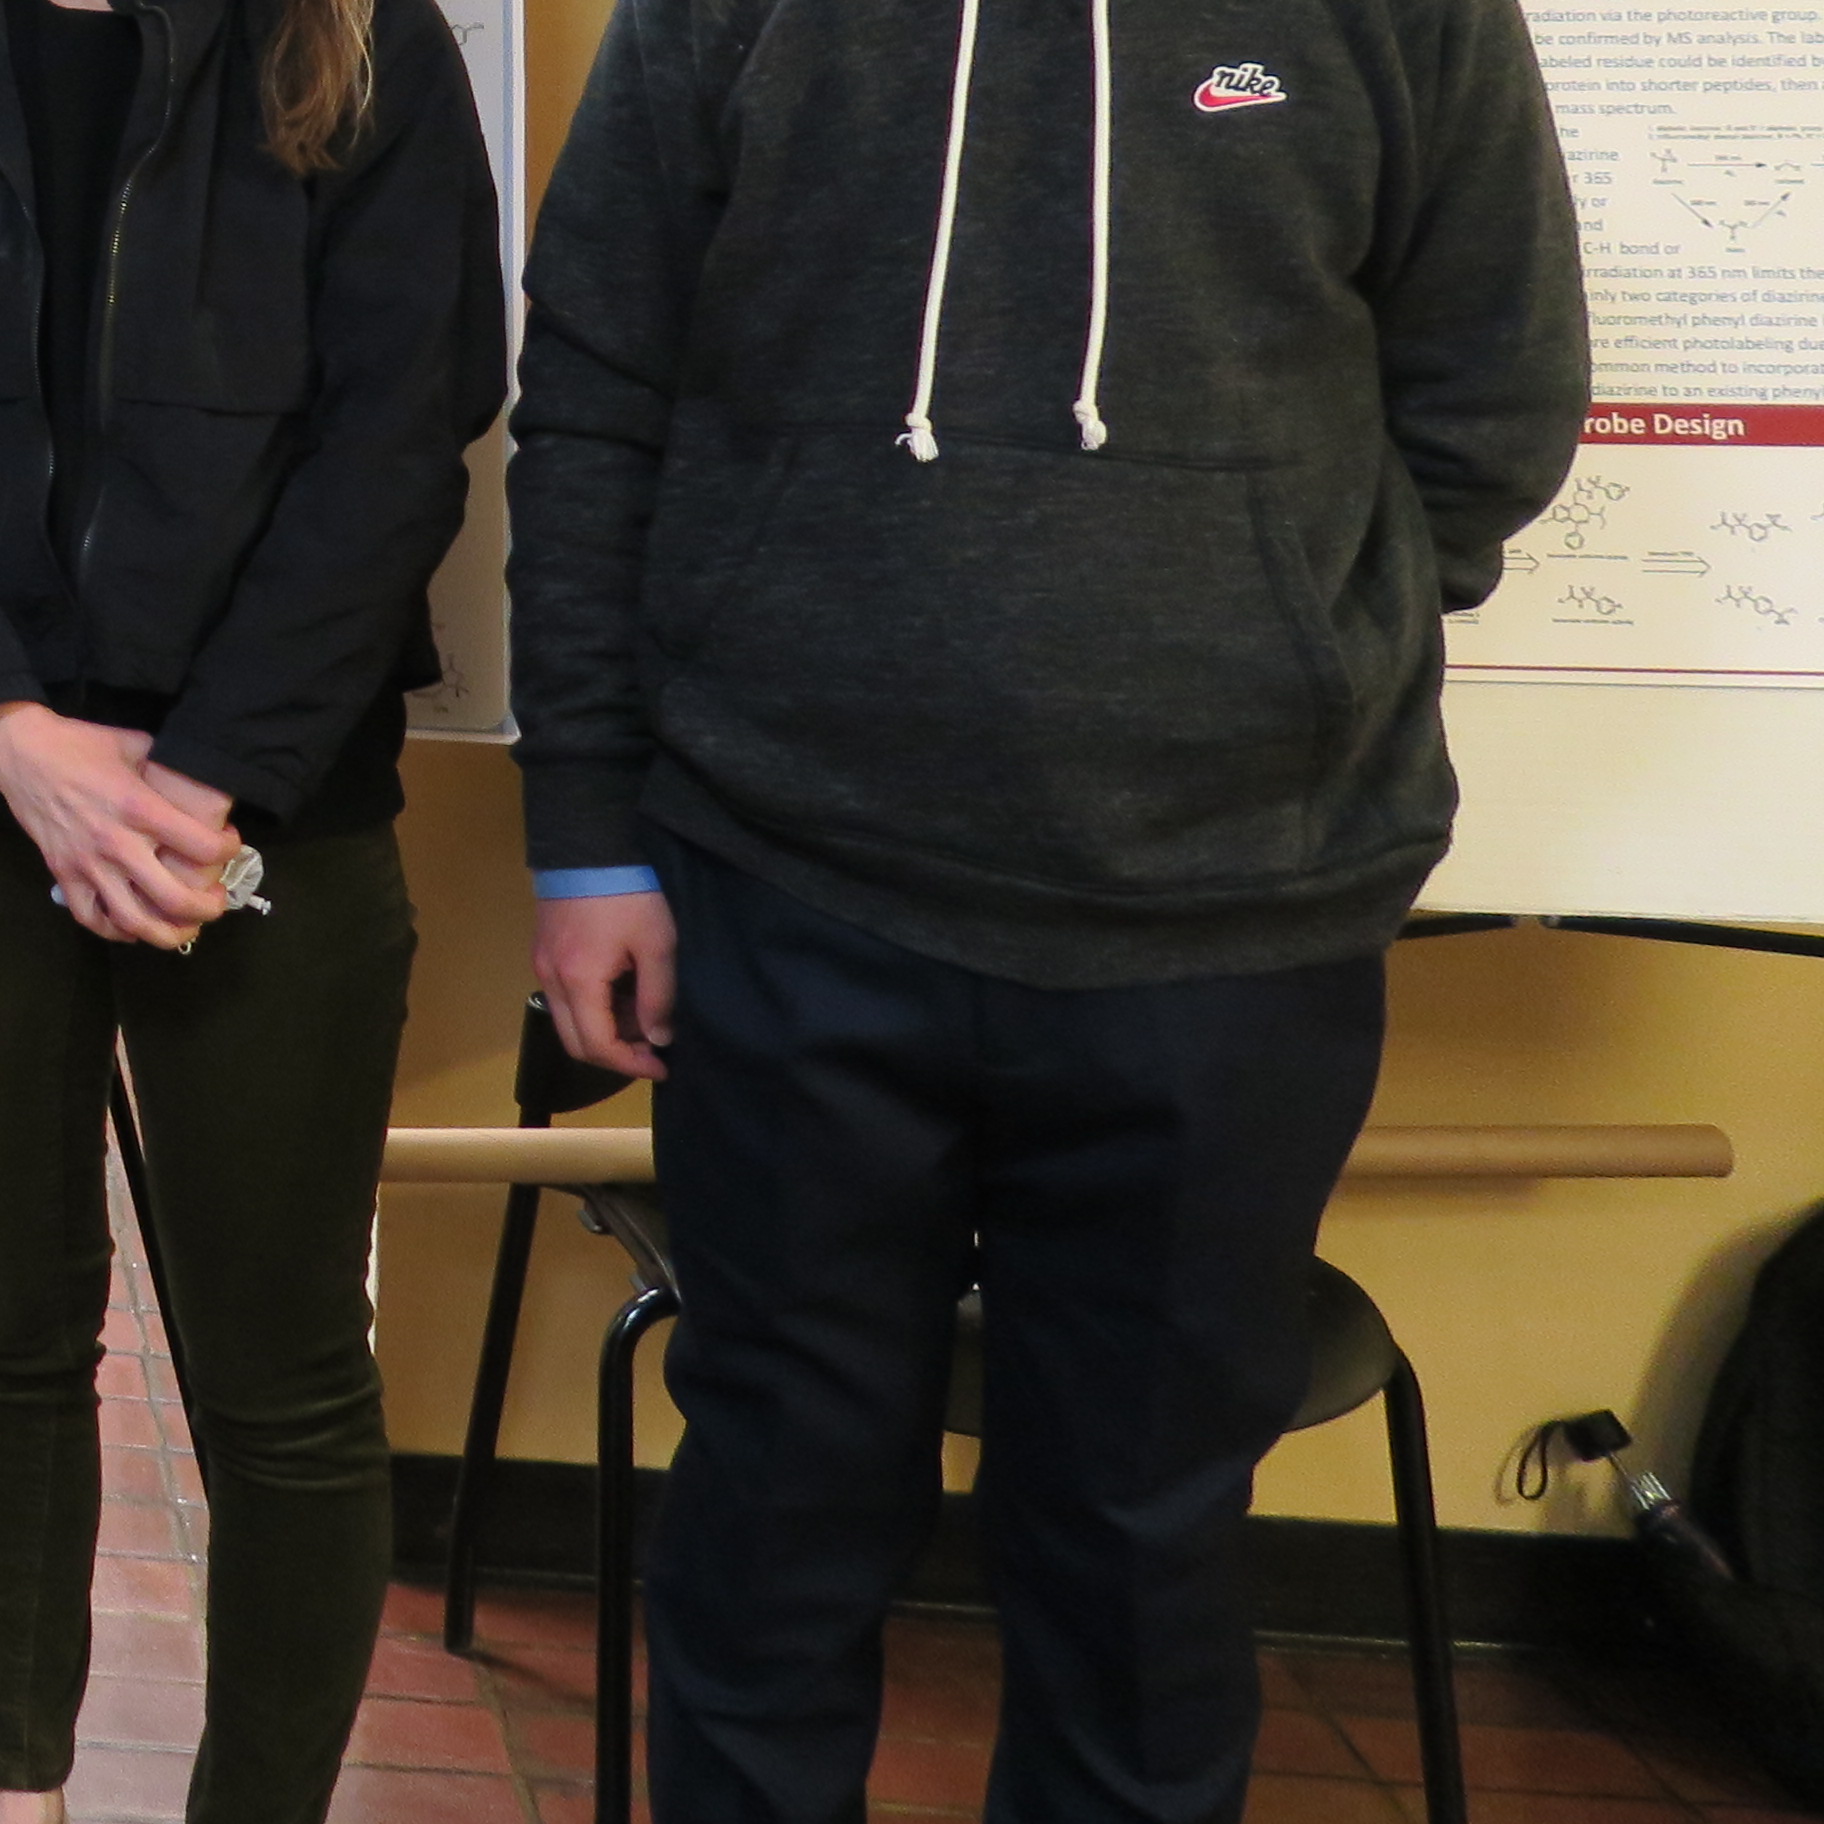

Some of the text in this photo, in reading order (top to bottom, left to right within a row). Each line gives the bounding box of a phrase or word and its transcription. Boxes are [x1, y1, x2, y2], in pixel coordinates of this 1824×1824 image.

[1601, 7, 1822, 25] via the photoreactive group.
[1535, 31, 1796, 48] be confirmed by MS analysis. The
[1597, 54, 1807, 69] residue could be identified
[1214, 66, 1276, 96] nike
[1606, 78, 1818, 94] into shorter peptides, then
[1555, 103, 1676, 118] mass spectrum.
[1667, 266, 1795, 280] at 365 nm limits
[1622, 289, 1758, 306] two categories of
[1692, 313, 1818, 330] phenyl diazirine
[1614, 335, 1794, 353] efficient photolabeling
[1654, 360, 1739, 374] method to
[1584, 412, 1745, 440] robe Design
